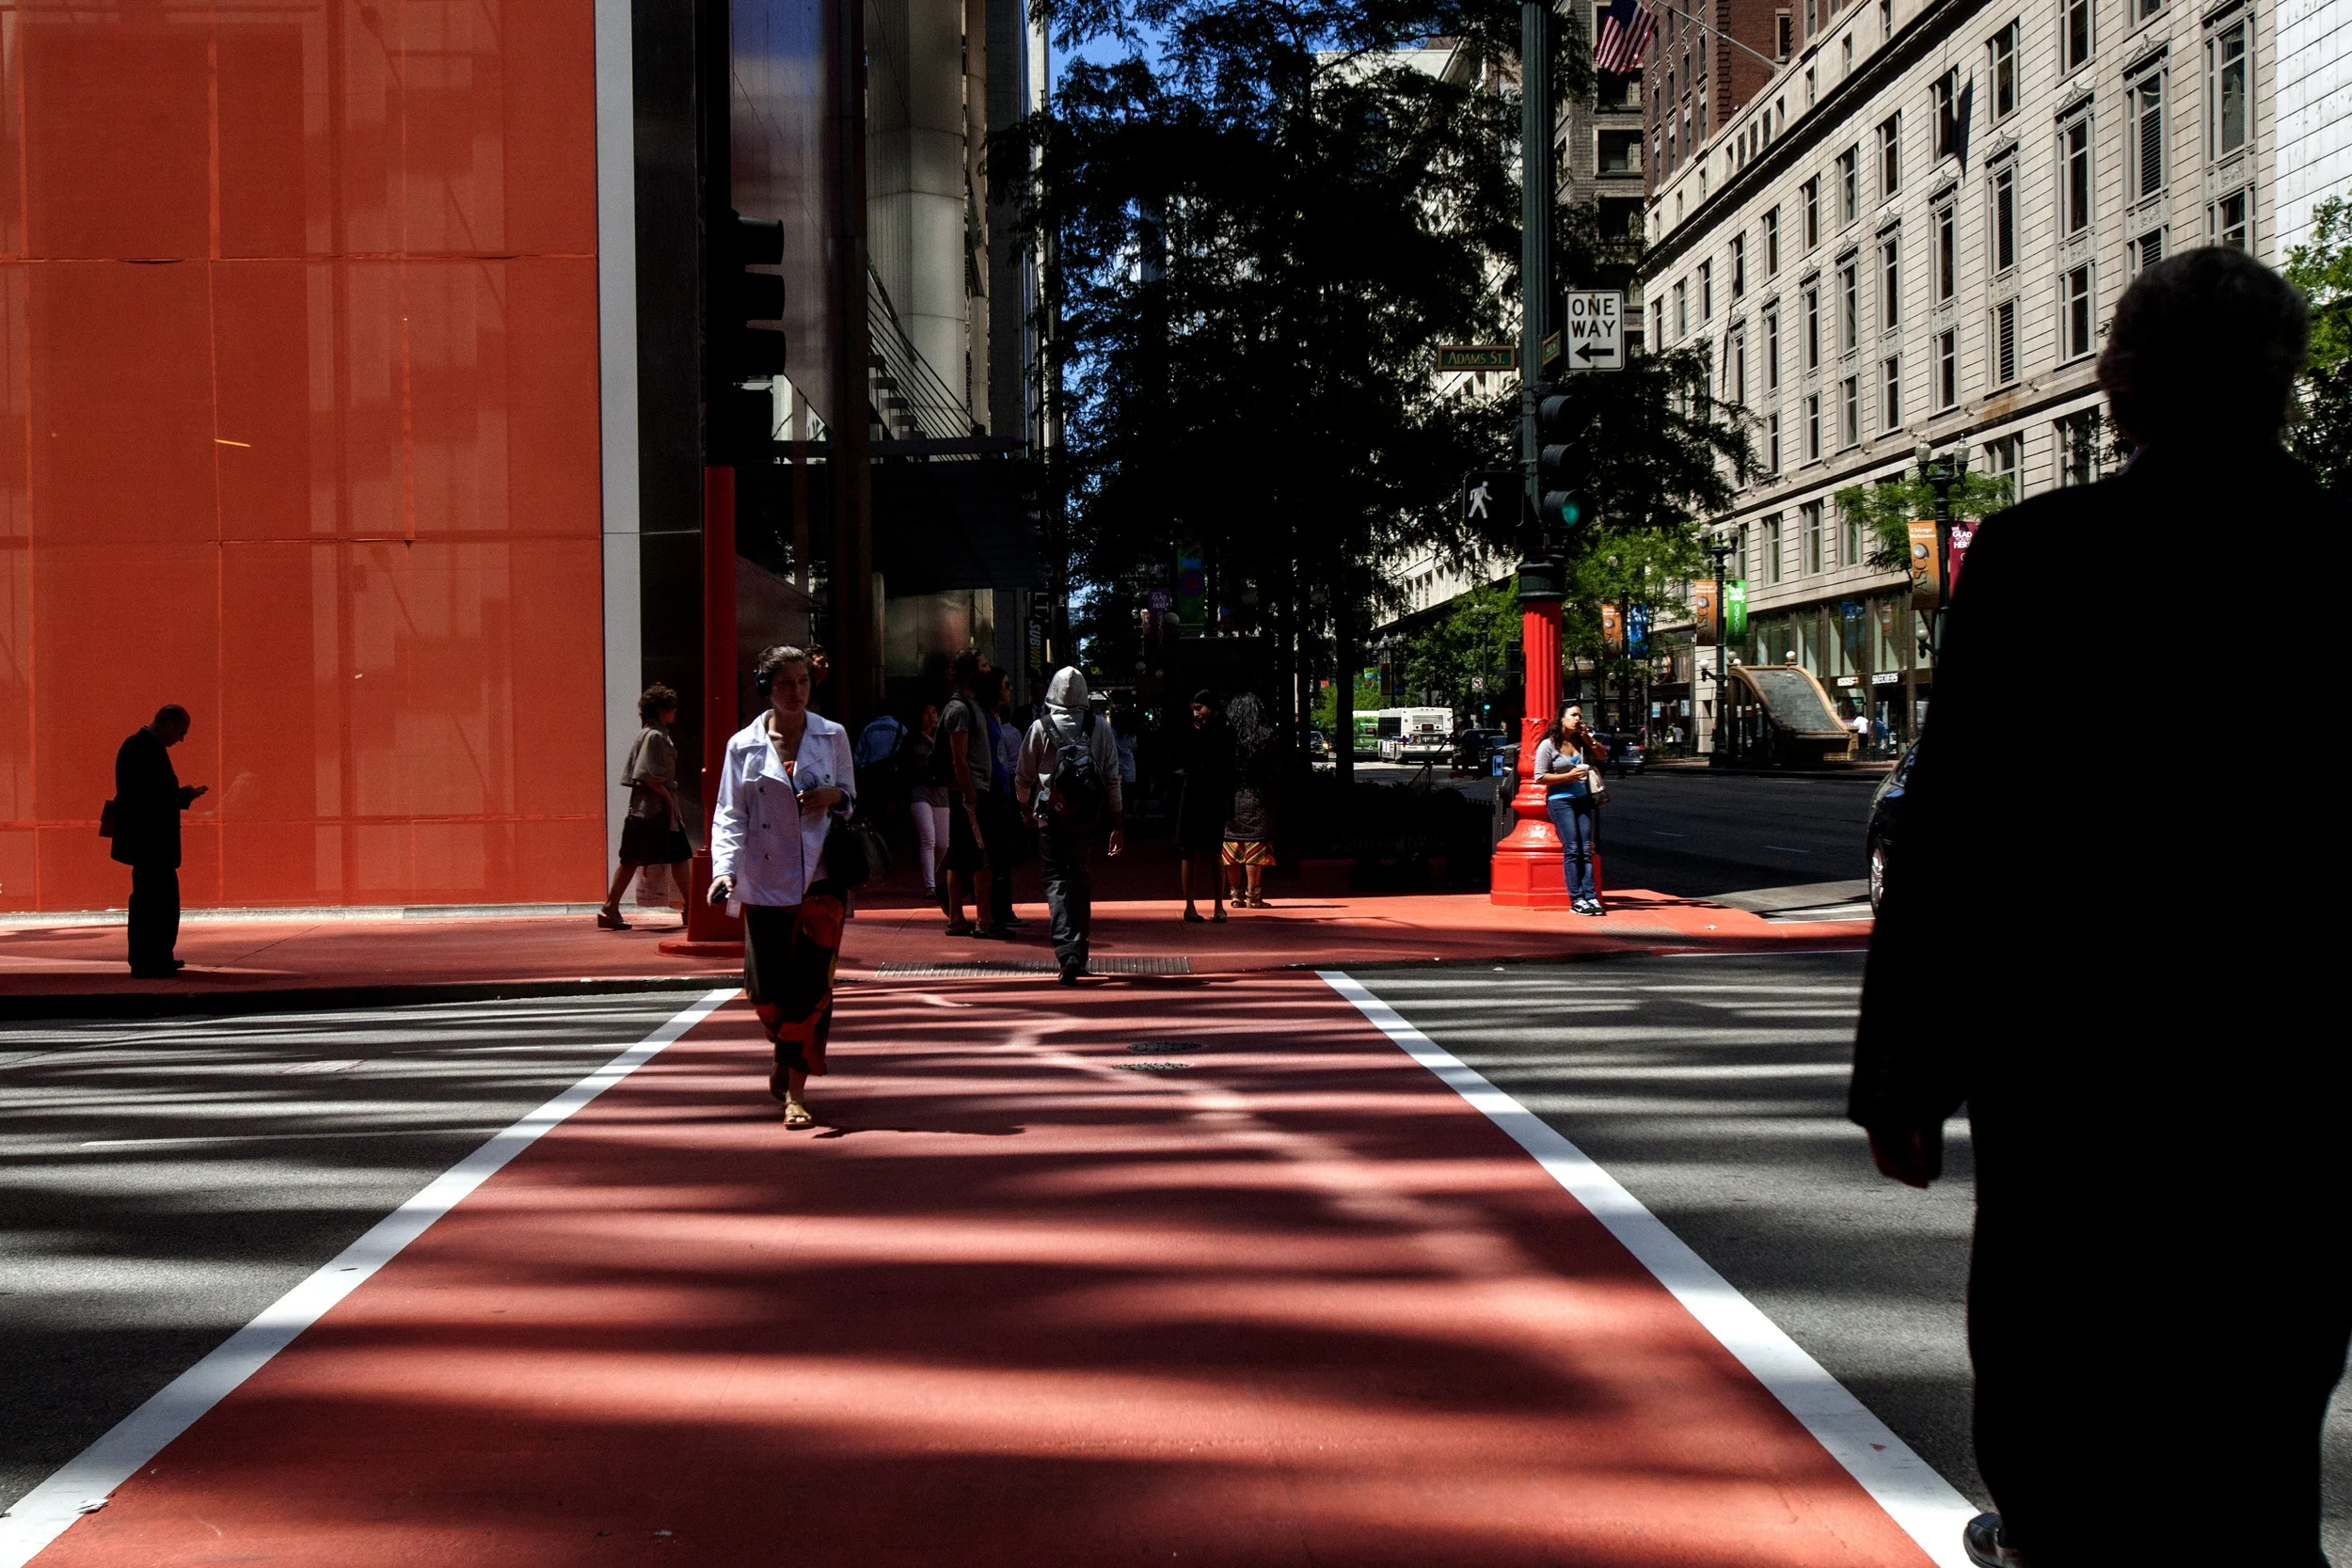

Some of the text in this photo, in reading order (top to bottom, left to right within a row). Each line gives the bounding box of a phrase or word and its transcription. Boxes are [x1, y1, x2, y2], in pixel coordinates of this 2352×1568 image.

[1572, 298, 1614, 316] ONE
[1571, 320, 1616, 339] WAY
[1028, 619, 1042, 678] SUBWAY
